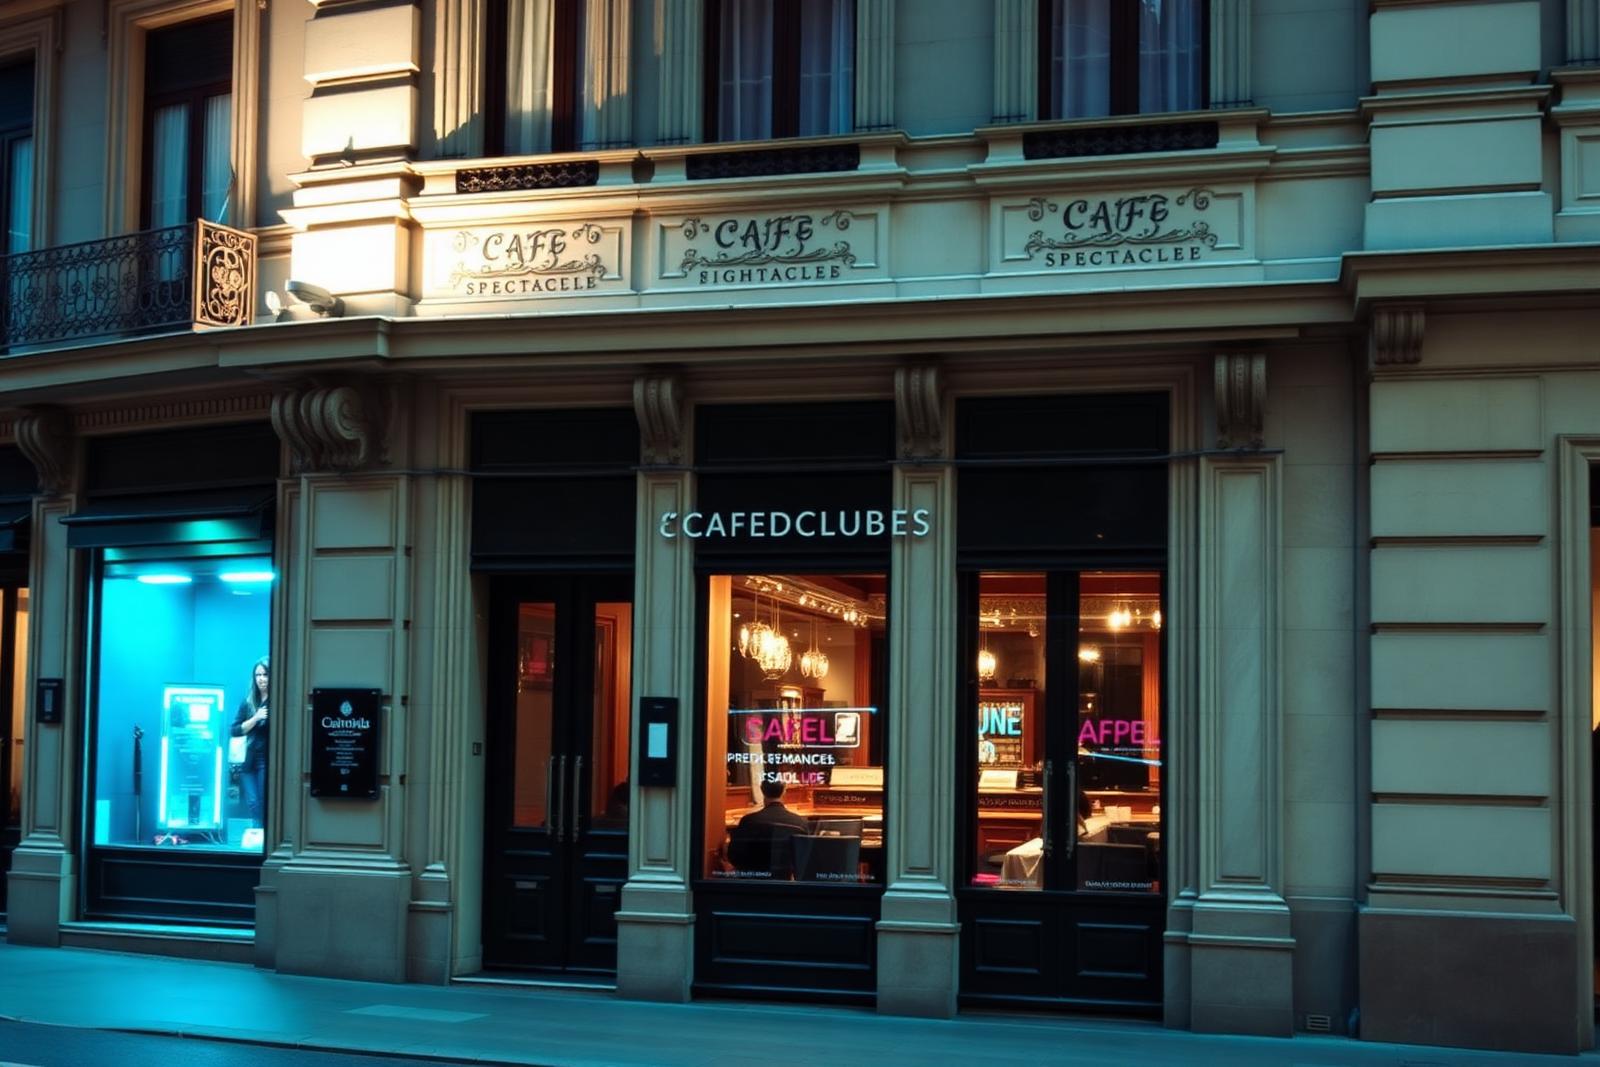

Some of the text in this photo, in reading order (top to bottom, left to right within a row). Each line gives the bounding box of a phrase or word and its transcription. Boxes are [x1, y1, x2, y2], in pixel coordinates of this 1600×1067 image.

[483, 229, 566, 264] CAFE
[1045, 246, 1202, 267] SPECTACLEE
[466, 276, 597, 295] SPECTACELE
